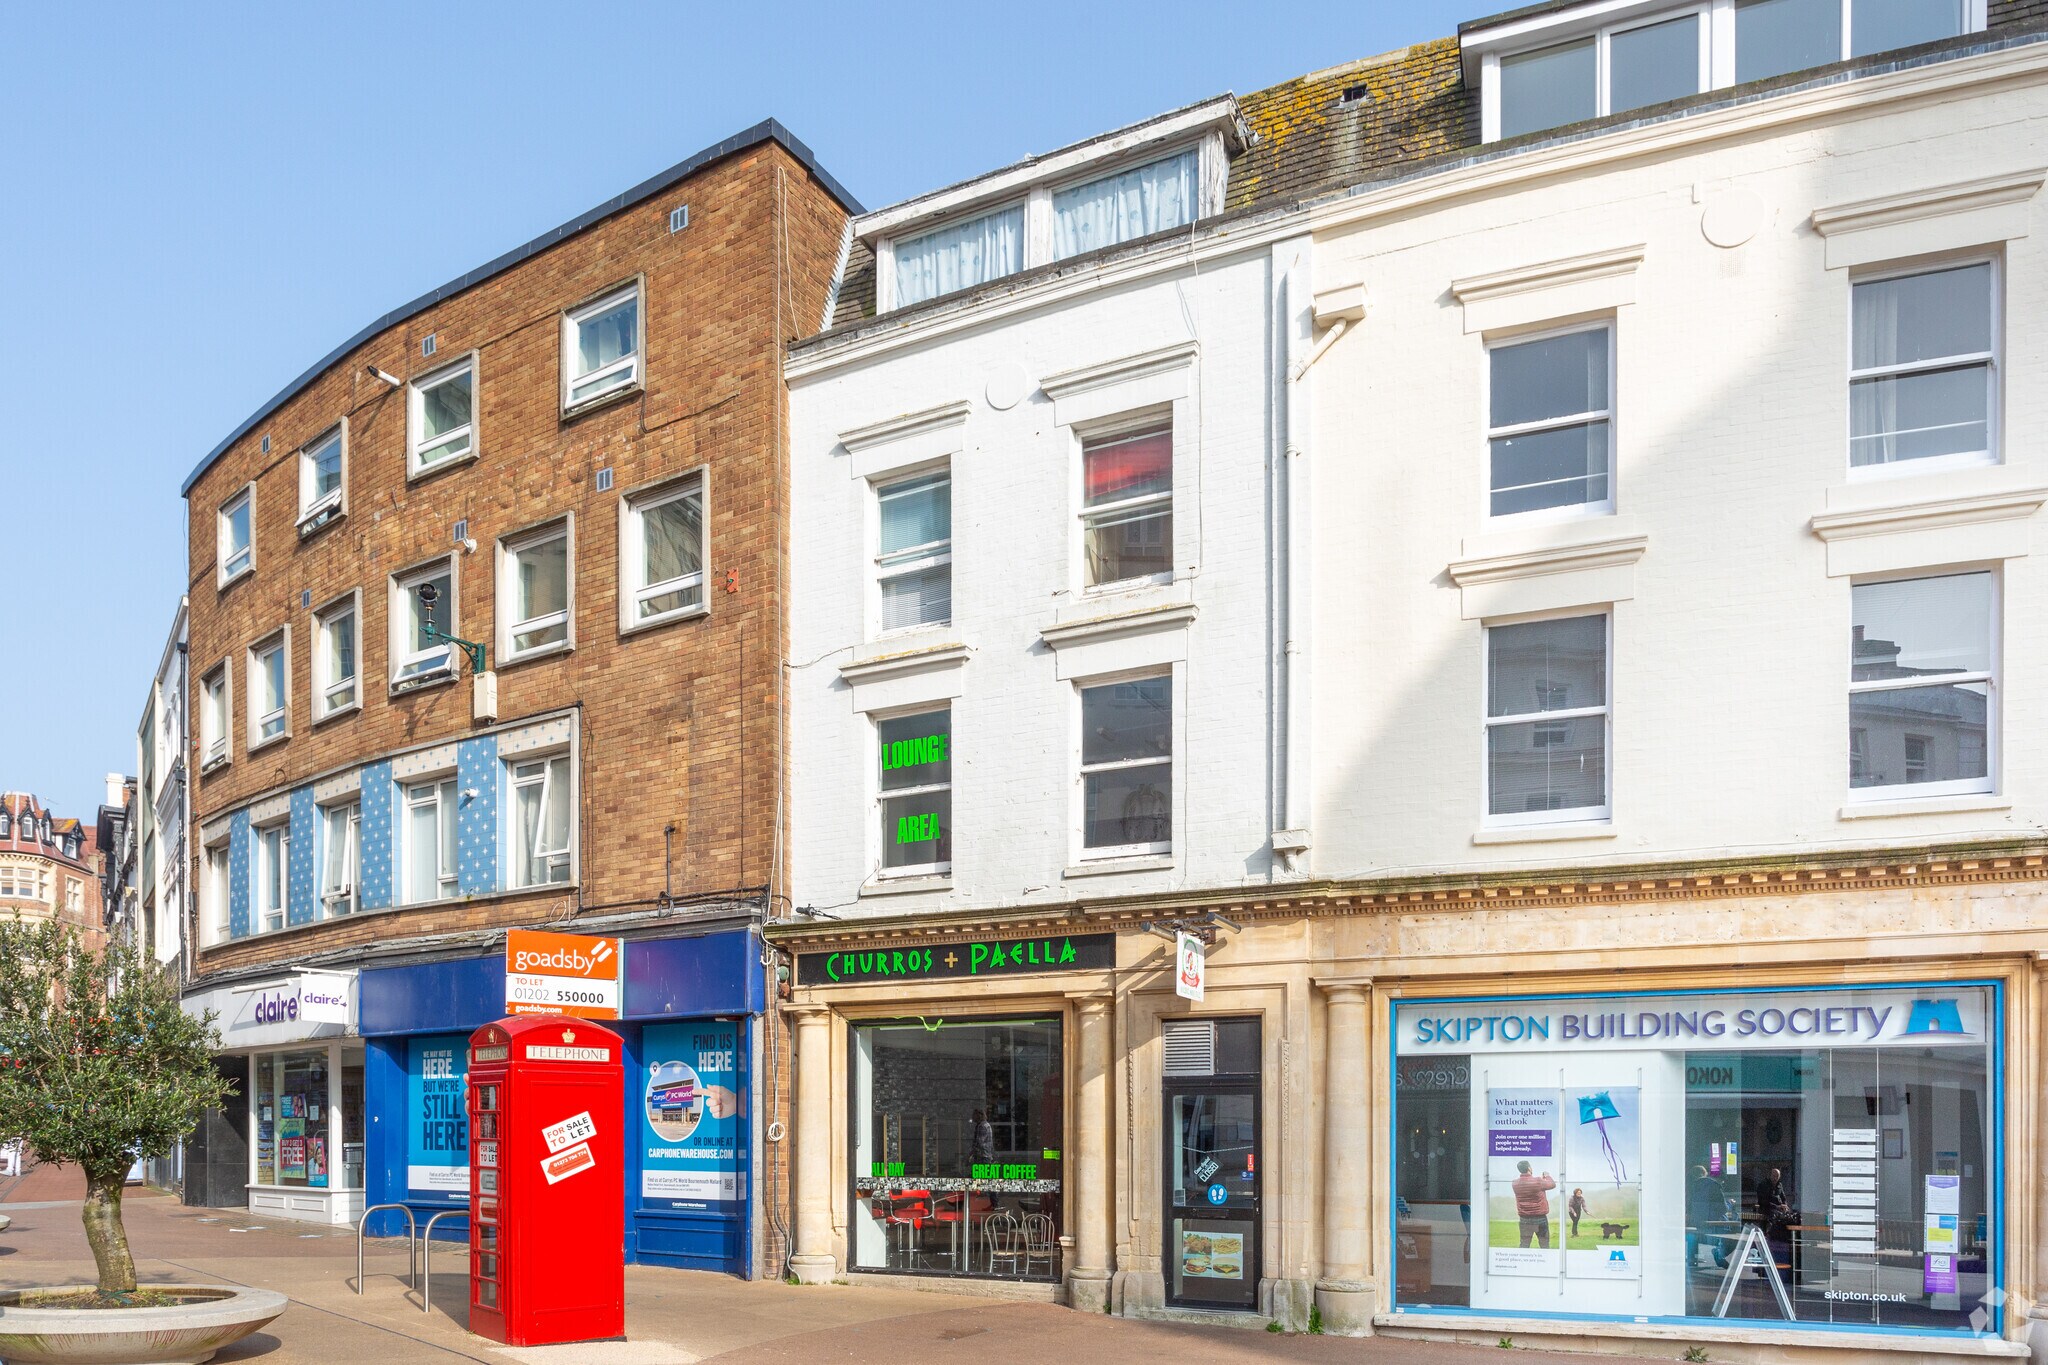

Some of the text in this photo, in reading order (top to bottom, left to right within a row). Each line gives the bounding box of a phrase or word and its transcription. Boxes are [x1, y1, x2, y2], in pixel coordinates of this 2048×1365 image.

[882, 733, 948, 771] LOUNGE
[897, 813, 940, 844] AREA
[515, 948, 596, 976] goadsby
[826, 949, 933, 982] CHURROS
[971, 937, 1077, 974] PAELLA
[515, 977, 527, 986] TO
[514, 987, 604, 1004] 01202 550000
[515, 1004, 562, 1014] goadsby.com
[1416, 1006, 1892, 1043] SKIPTON BUILDING SOCIETY
[693, 1034, 732, 1050] FIND US
[530, 1047, 606, 1060] TELEPHONE
[698, 1051, 732, 1072] HERE
[423, 1080, 459, 1093] BUT WE'RE
[678, 1090, 692, 1098] World
[423, 1094, 460, 1119] STILL
[1495, 1098, 1518, 1106] What
[1495, 1108, 1502, 1116] is
[1511, 1108, 1547, 1117] brighter
[547, 1116, 589, 1139] FOR SALE
[423, 1121, 466, 1151] HERE
[550, 1125, 591, 1147] TO LET
[694, 1136, 733, 1146] OR ONLINE AT
[281, 1146, 303, 1165] FREE
[648, 1148, 734, 1159] CARPHONEWAREHOUSE.COM
[888, 1162, 905, 1177] DAY
[972, 1164, 1036, 1179] GREAT COFFEE
[1824, 1290, 1906, 1302] skipton.co.uk
